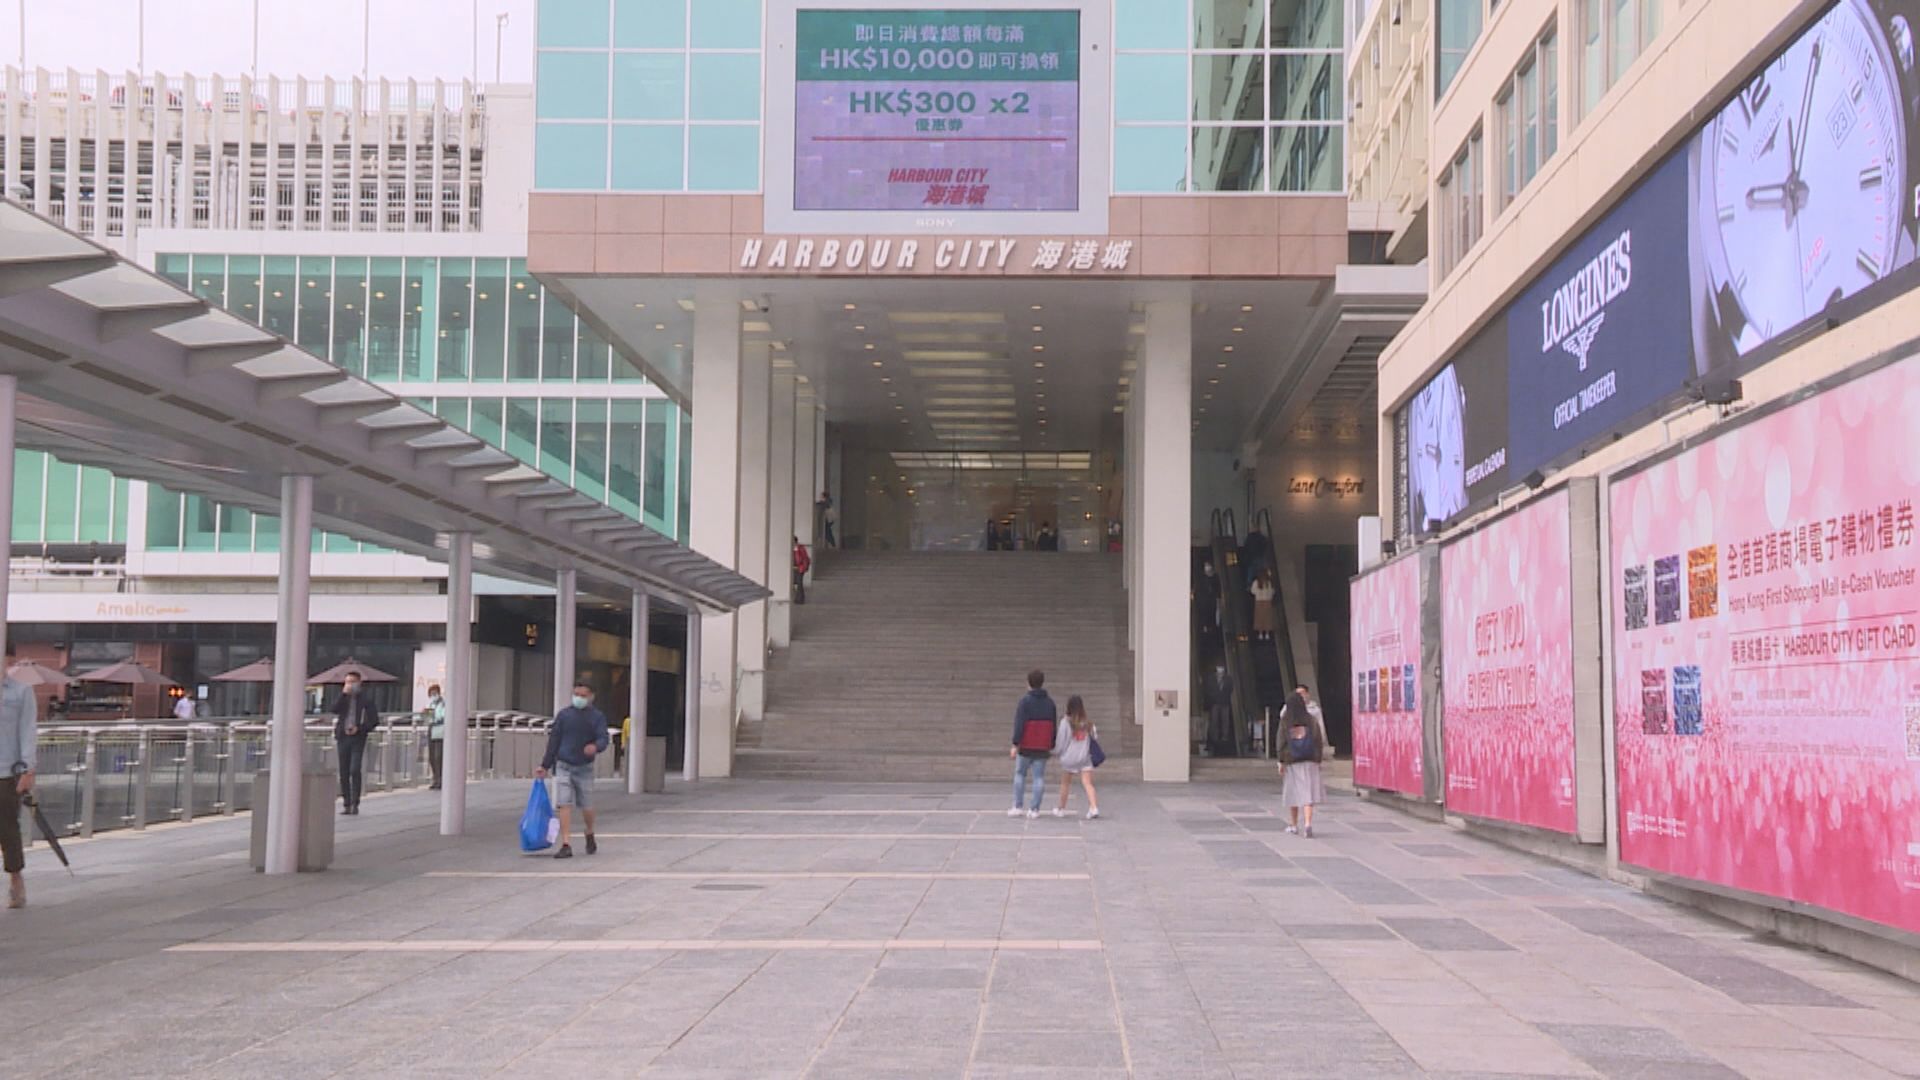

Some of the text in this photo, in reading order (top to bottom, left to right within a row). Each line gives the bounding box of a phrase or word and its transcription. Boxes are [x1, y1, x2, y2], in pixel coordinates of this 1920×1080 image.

[856, 24, 1024, 43] 即日消費總額每滿
[820, 46, 1059, 72] HK$10,000 即可換領
[849, 89, 1029, 117] HK$300 x2
[888, 168, 989, 183] HARBOUR CITY
[923, 184, 990, 205] 海港城
[916, 218, 954, 227] SONY
[739, 238, 1133, 270] HARBOUR CITY 海港城
[1541, 229, 1632, 353] LONGINES
[1554, 369, 1617, 430] OFFICIAL TIMEKEEPER
[1287, 477, 1315, 494] Lane
[1727, 499, 1914, 581] 全港首張商場電子購物禮券
[1729, 567, 1916, 614] Hong Kong First Shopping Mall e-Cash Voucher
[1501, 602, 1526, 653] YOU
[1783, 631, 1829, 657] HARBOUR
[1830, 629, 1854, 654] CITY
[1856, 626, 1880, 652] GIFT
[1882, 623, 1916, 650] CARD
[1466, 663, 1538, 712] EVERYTHING
